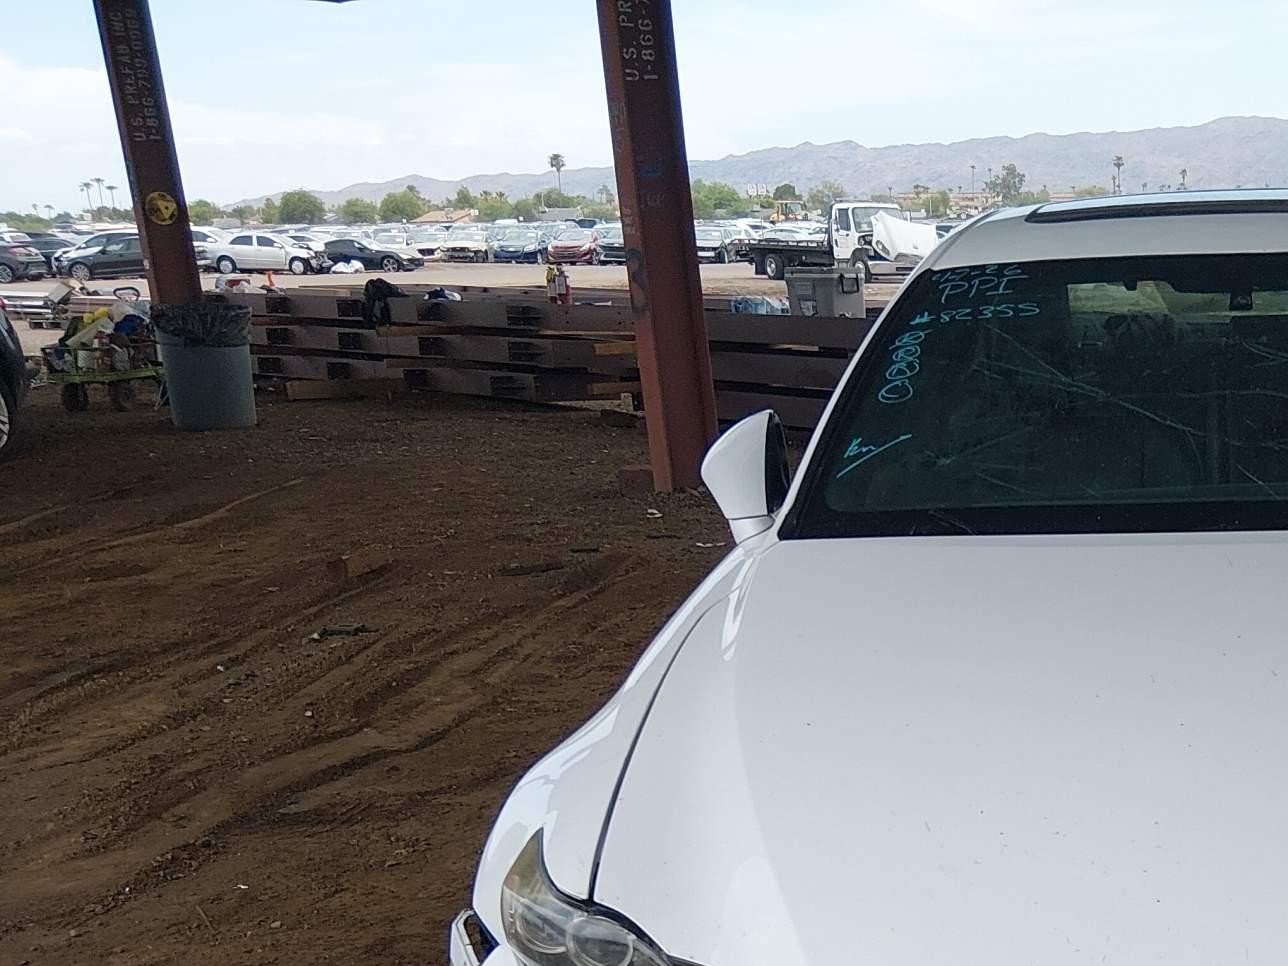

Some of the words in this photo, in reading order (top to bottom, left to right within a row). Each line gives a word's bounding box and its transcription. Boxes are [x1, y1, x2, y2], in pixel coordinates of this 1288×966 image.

[109, 11, 126, 36] INC
[622, 41, 640, 81] U.S.
[938, 275, 1030, 304] PPI
